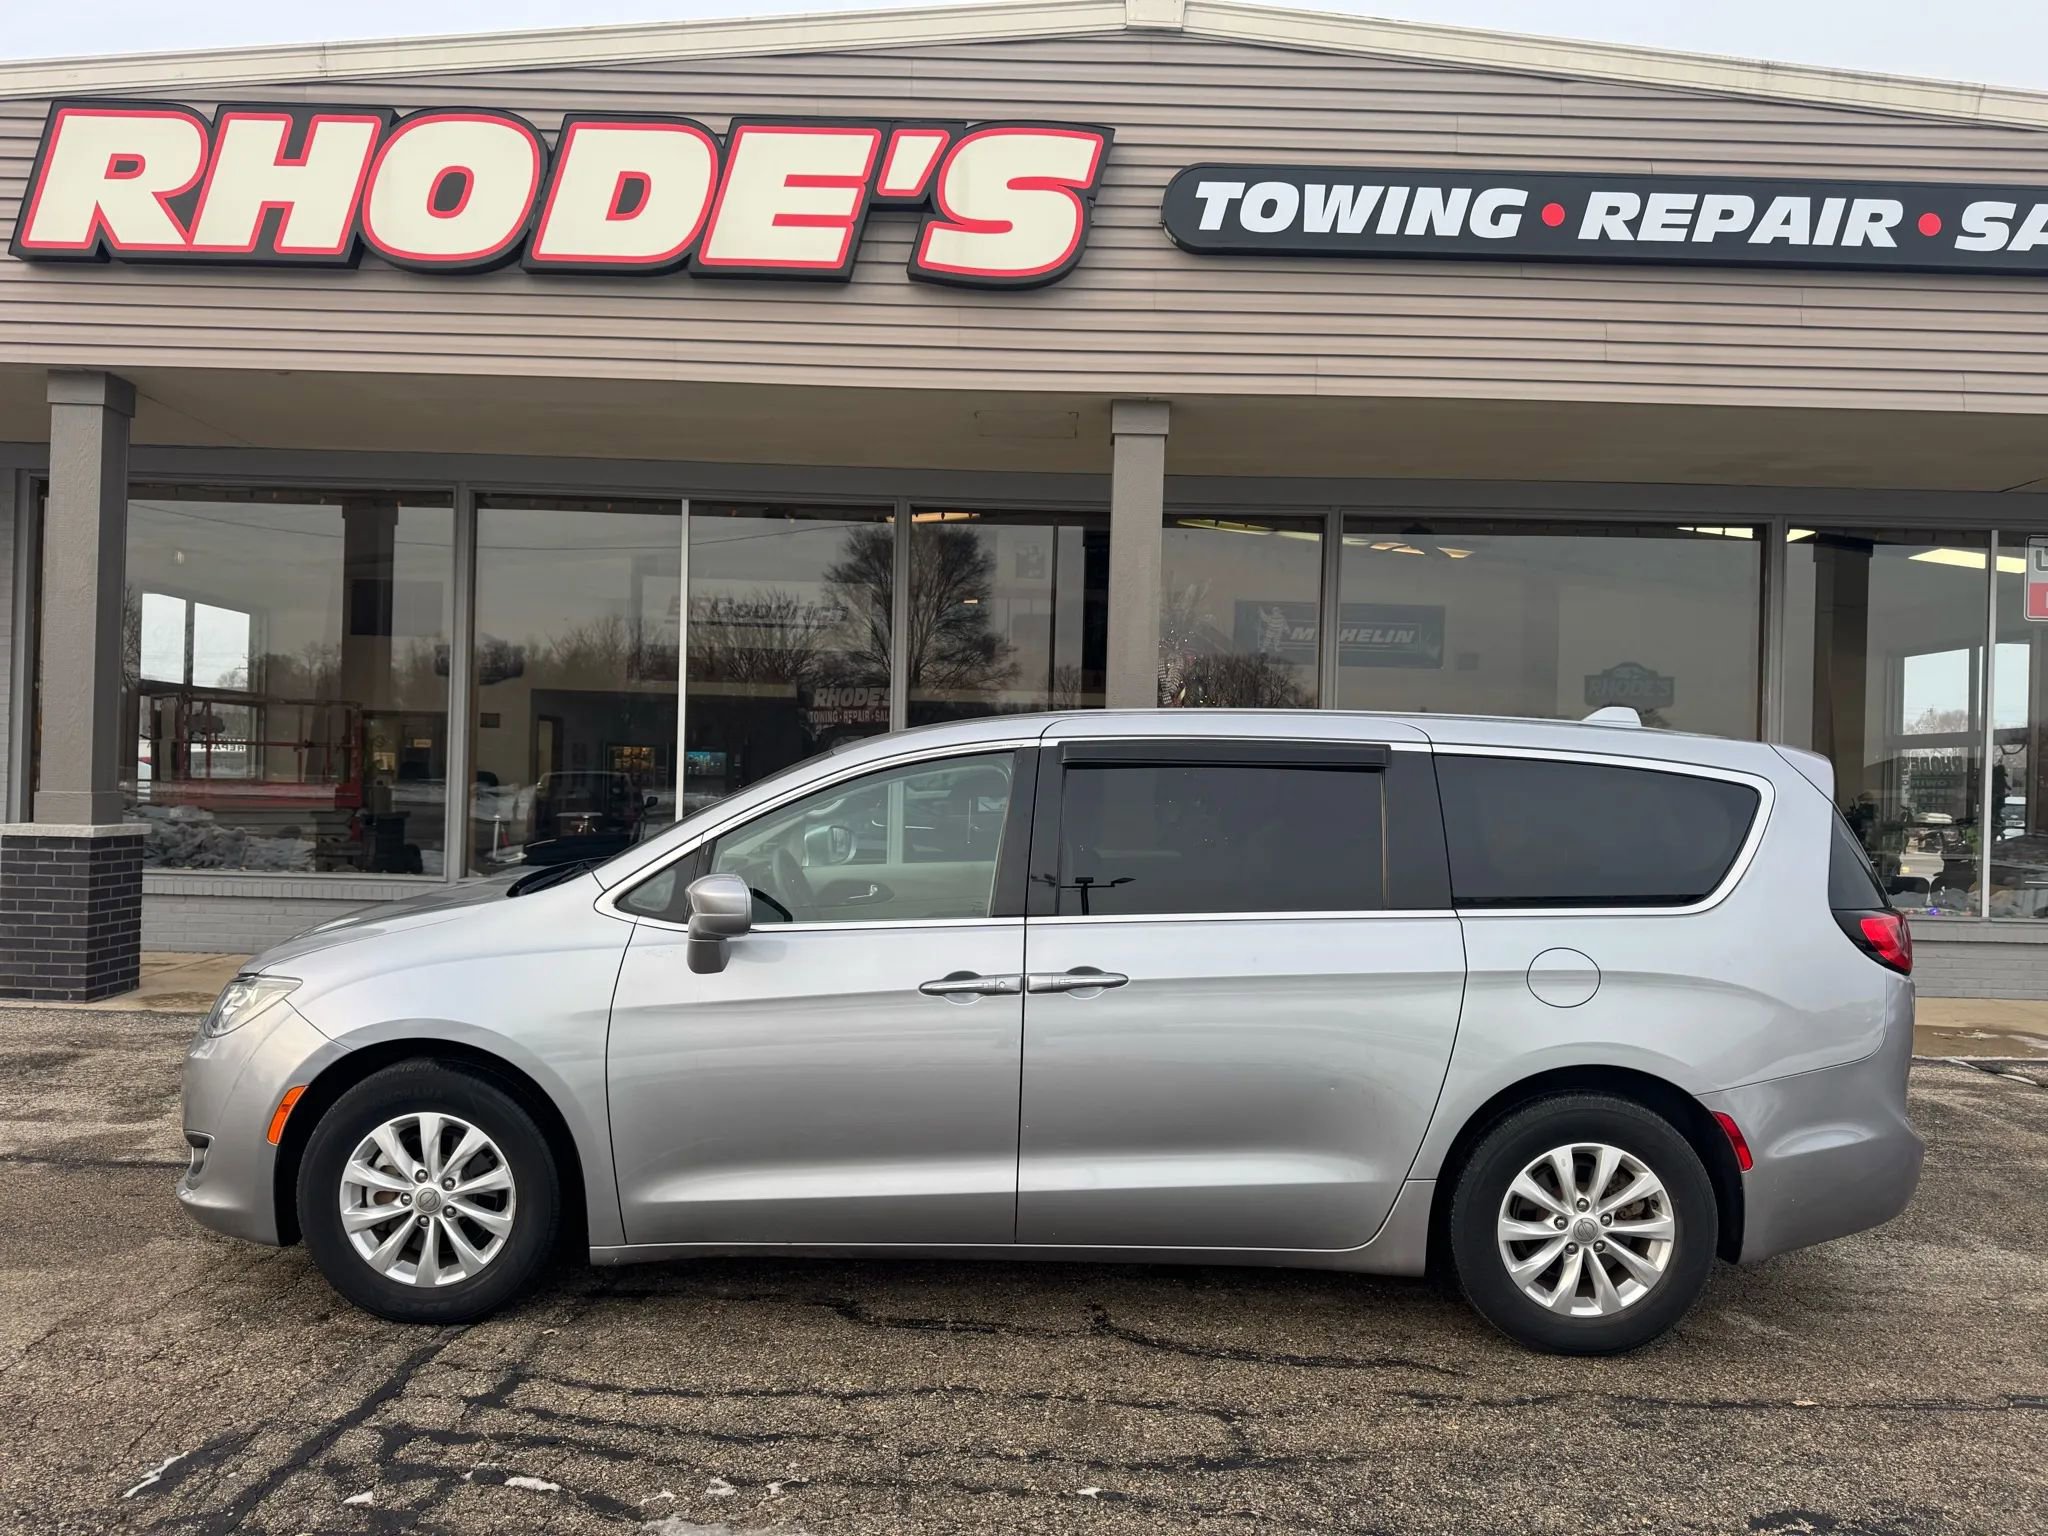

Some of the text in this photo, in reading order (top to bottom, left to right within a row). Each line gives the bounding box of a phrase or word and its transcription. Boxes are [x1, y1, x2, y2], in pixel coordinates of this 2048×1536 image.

[20, 108, 1103, 272] RHODE'S
[1195, 180, 1529, 239] TOWING
[1577, 191, 1904, 249] REPAIR
[1289, 626, 1415, 644] MHELIN
[809, 710, 838, 723] TOWING
[843, 710, 870, 722] REPAIR
